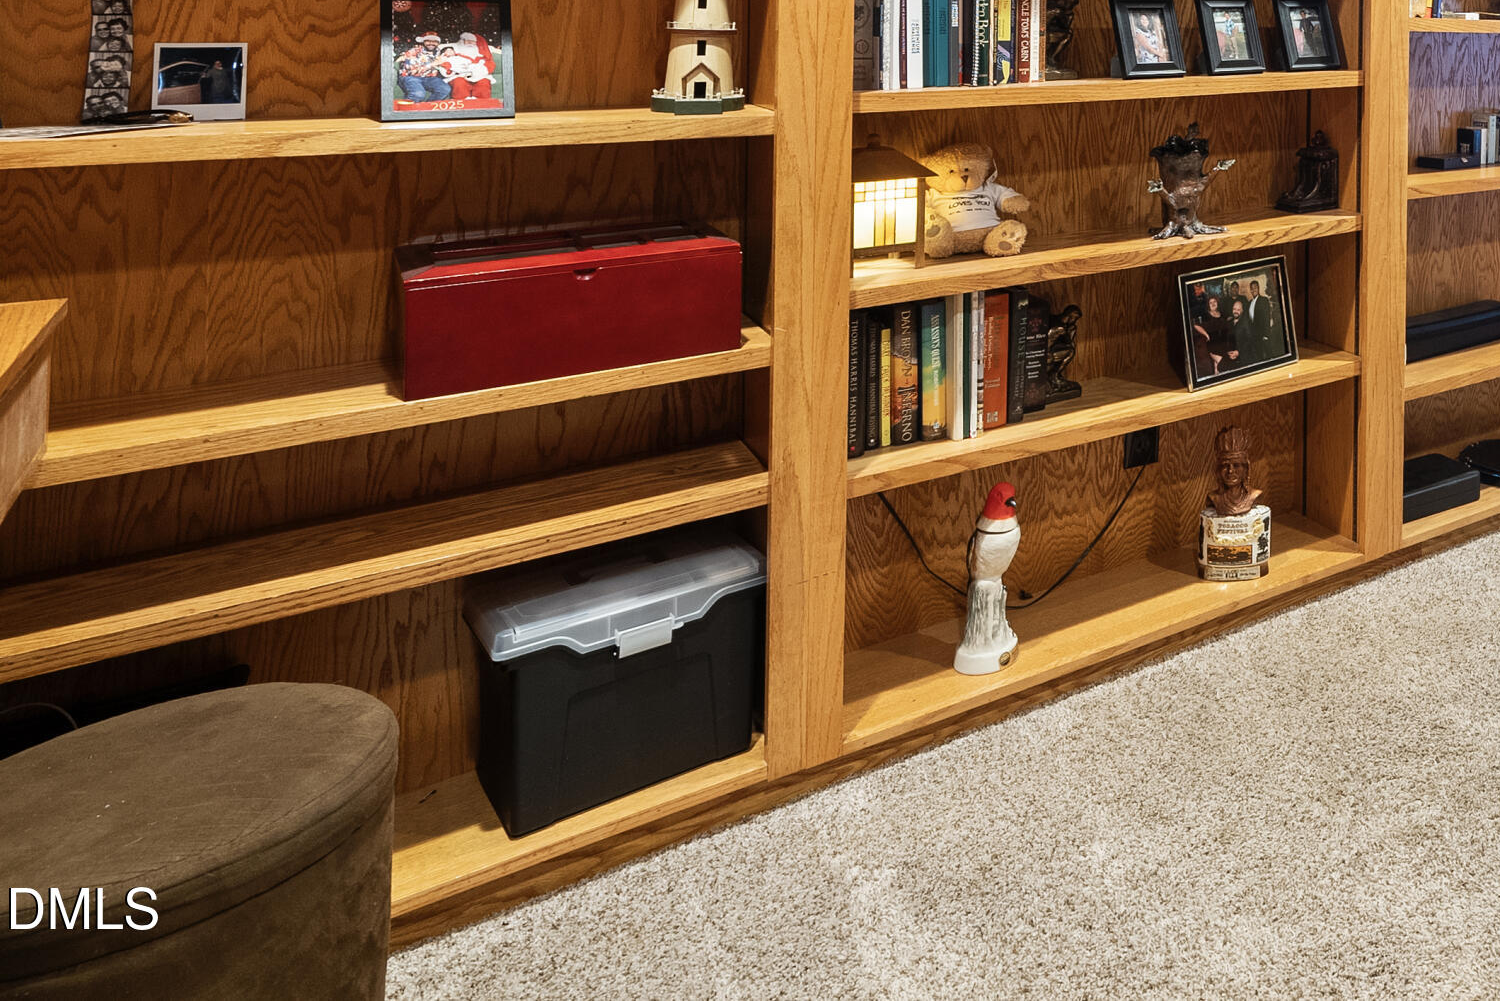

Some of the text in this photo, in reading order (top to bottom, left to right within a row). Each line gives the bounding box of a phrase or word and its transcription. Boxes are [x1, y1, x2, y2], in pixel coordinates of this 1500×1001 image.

[1020, 40, 1029, 62] CABIN
[431, 100, 465, 111] 2025
[901, 310, 911, 335] DAN
[1017, 317, 1028, 358] HOUSE
[900, 337, 912, 377] BROWN
[848, 320, 859, 445] THOMAS HARRIS HANNIBAL
[897, 384, 916, 442] INFERNO
